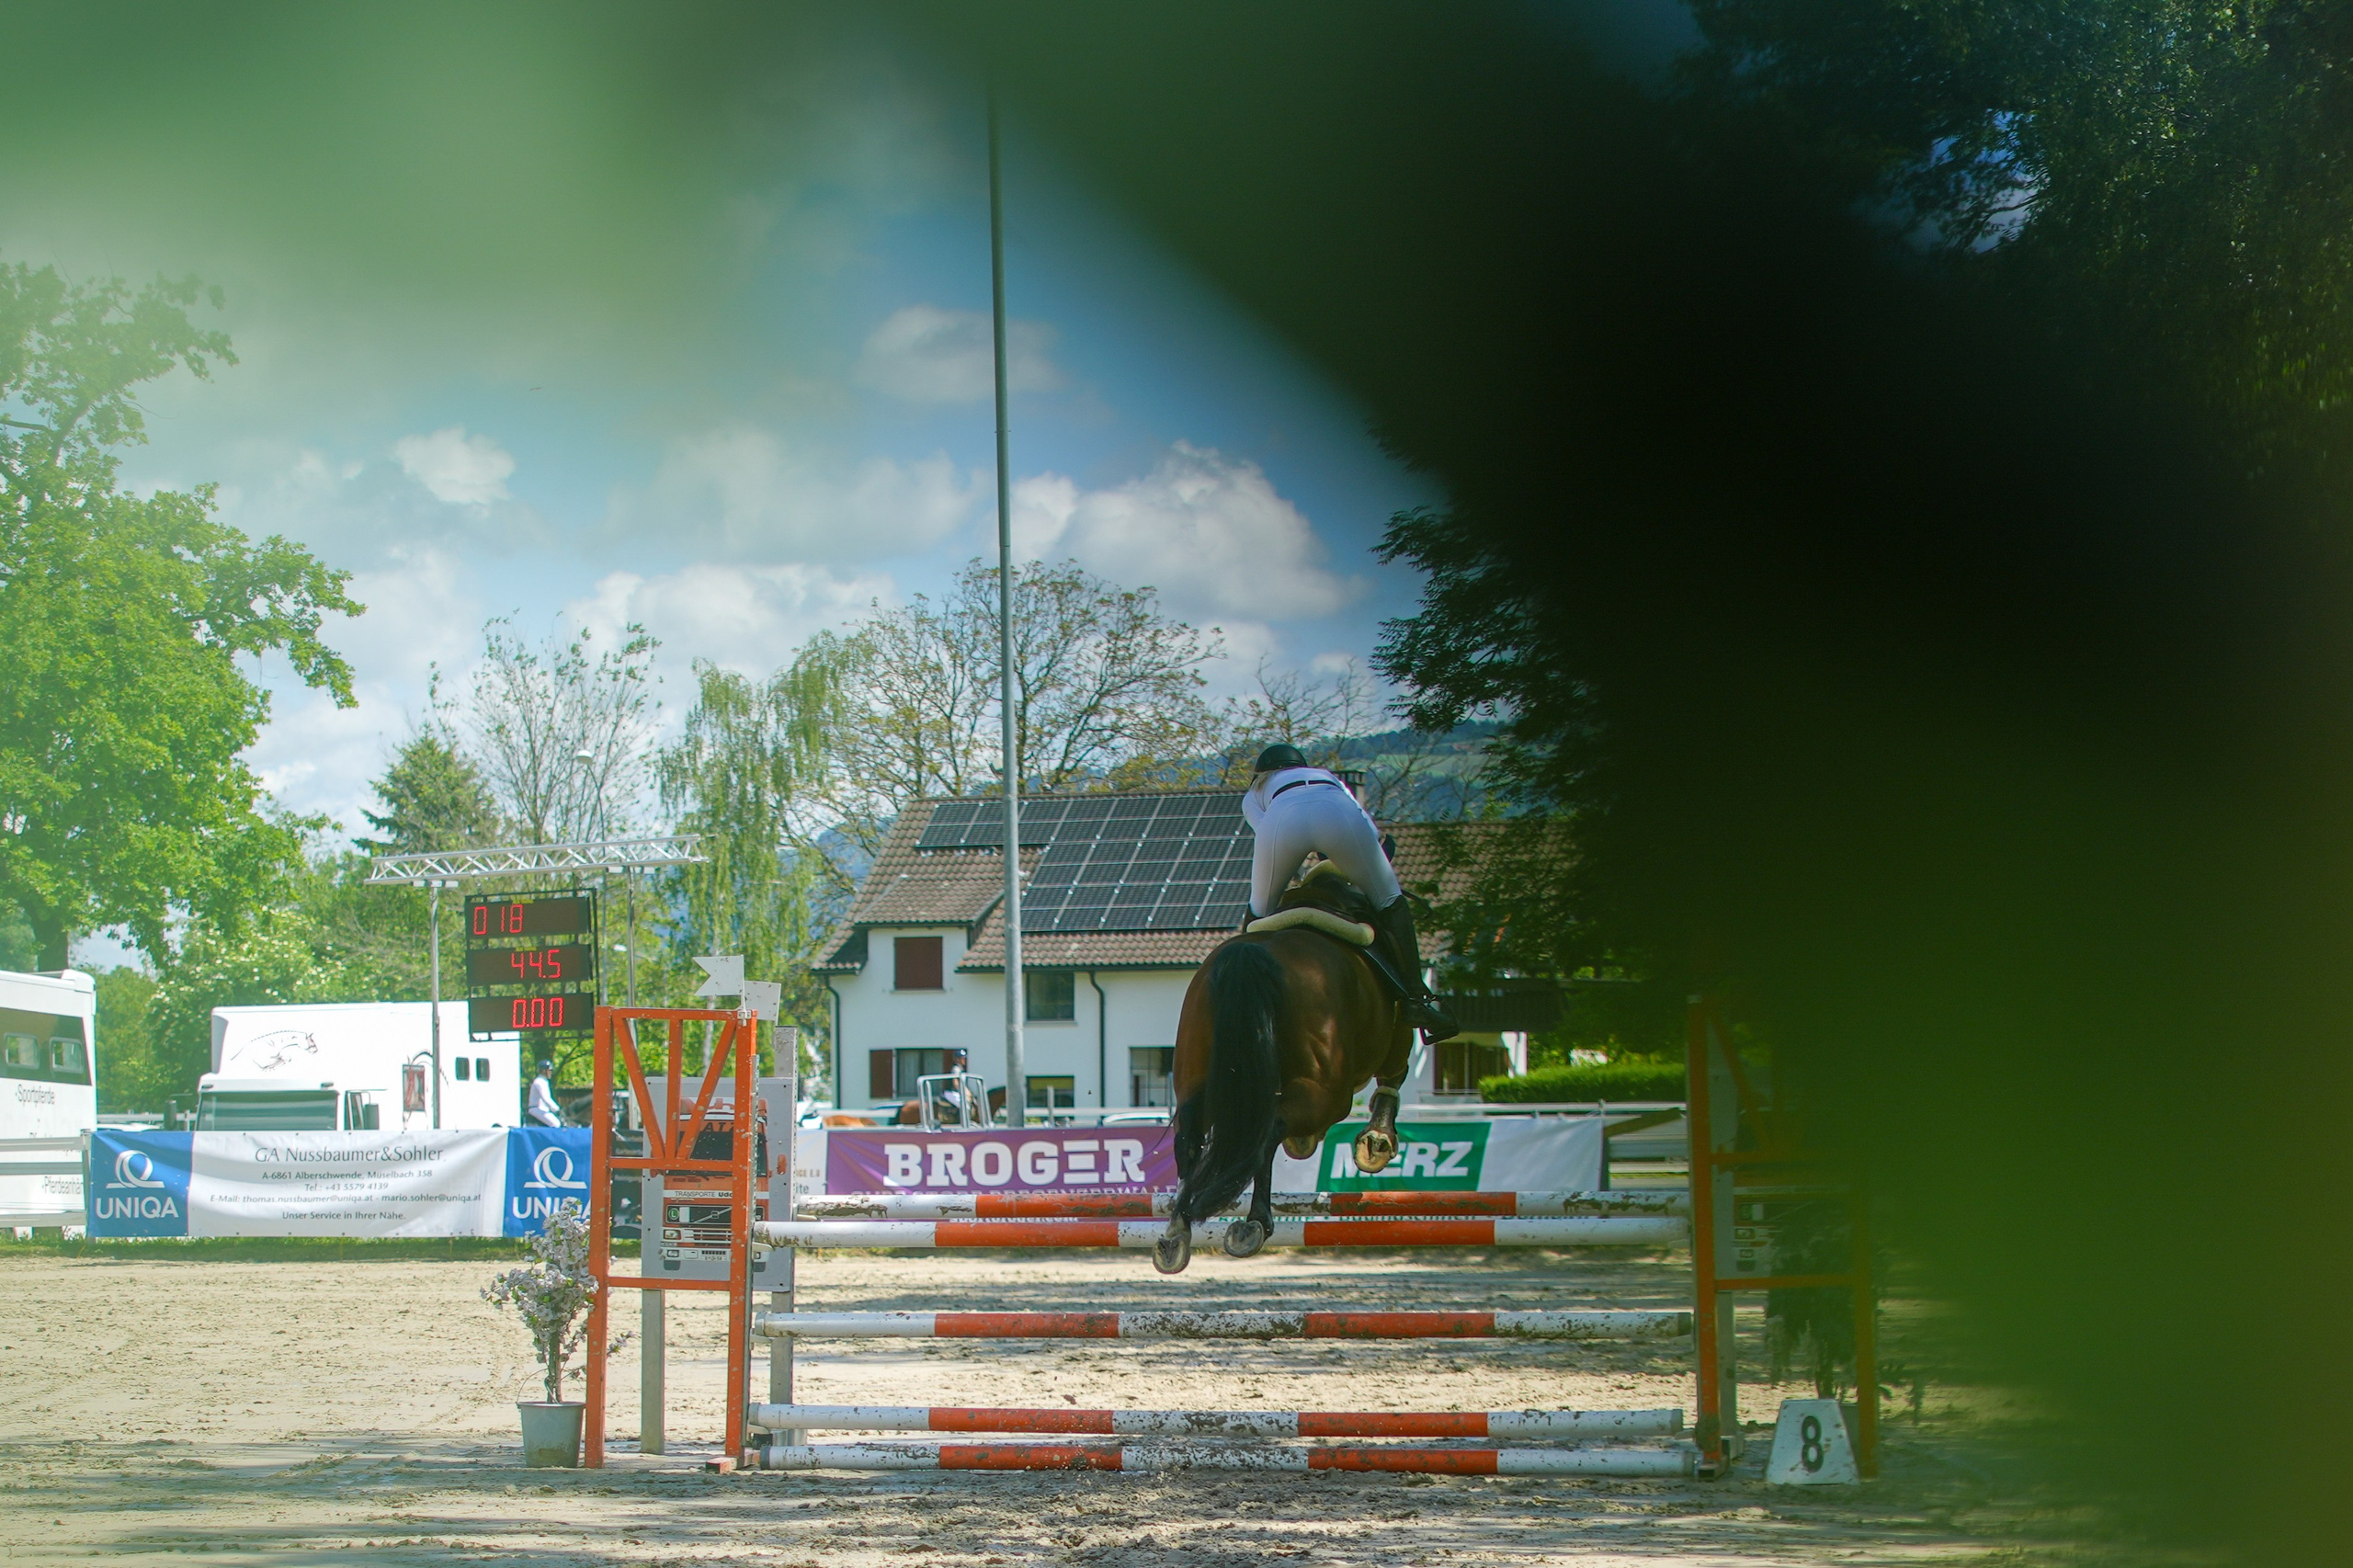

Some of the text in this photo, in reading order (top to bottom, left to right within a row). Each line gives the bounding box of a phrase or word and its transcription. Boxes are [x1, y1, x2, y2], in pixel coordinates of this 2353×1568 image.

[511, 949, 562, 979] 44.5
[512, 996, 564, 1028] 0.00
[17, 1084, 55, 1108] Sportpferde
[255, 1147, 280, 1163] GA
[882, 1139, 1146, 1187] BROGER
[1330, 1141, 1473, 1179] MERZ
[261, 1172, 292, 1180] A-6861
[294, 1171, 365, 1181] Alberschwende,
[368, 1170, 415, 1179] Müselbach
[324, 1183, 341, 1191] +43
[343, 1183, 365, 1191] 5579
[368, 1182, 389, 1190] 4139
[95, 1196, 179, 1219] UNIQA
[282, 1211, 307, 1220] Unser
[310, 1210, 341, 1220] Service
[355, 1210, 377, 1220] Ihrer
[379, 1210, 406, 1220] Nähe.
[1801, 1415, 1824, 1472] 8
